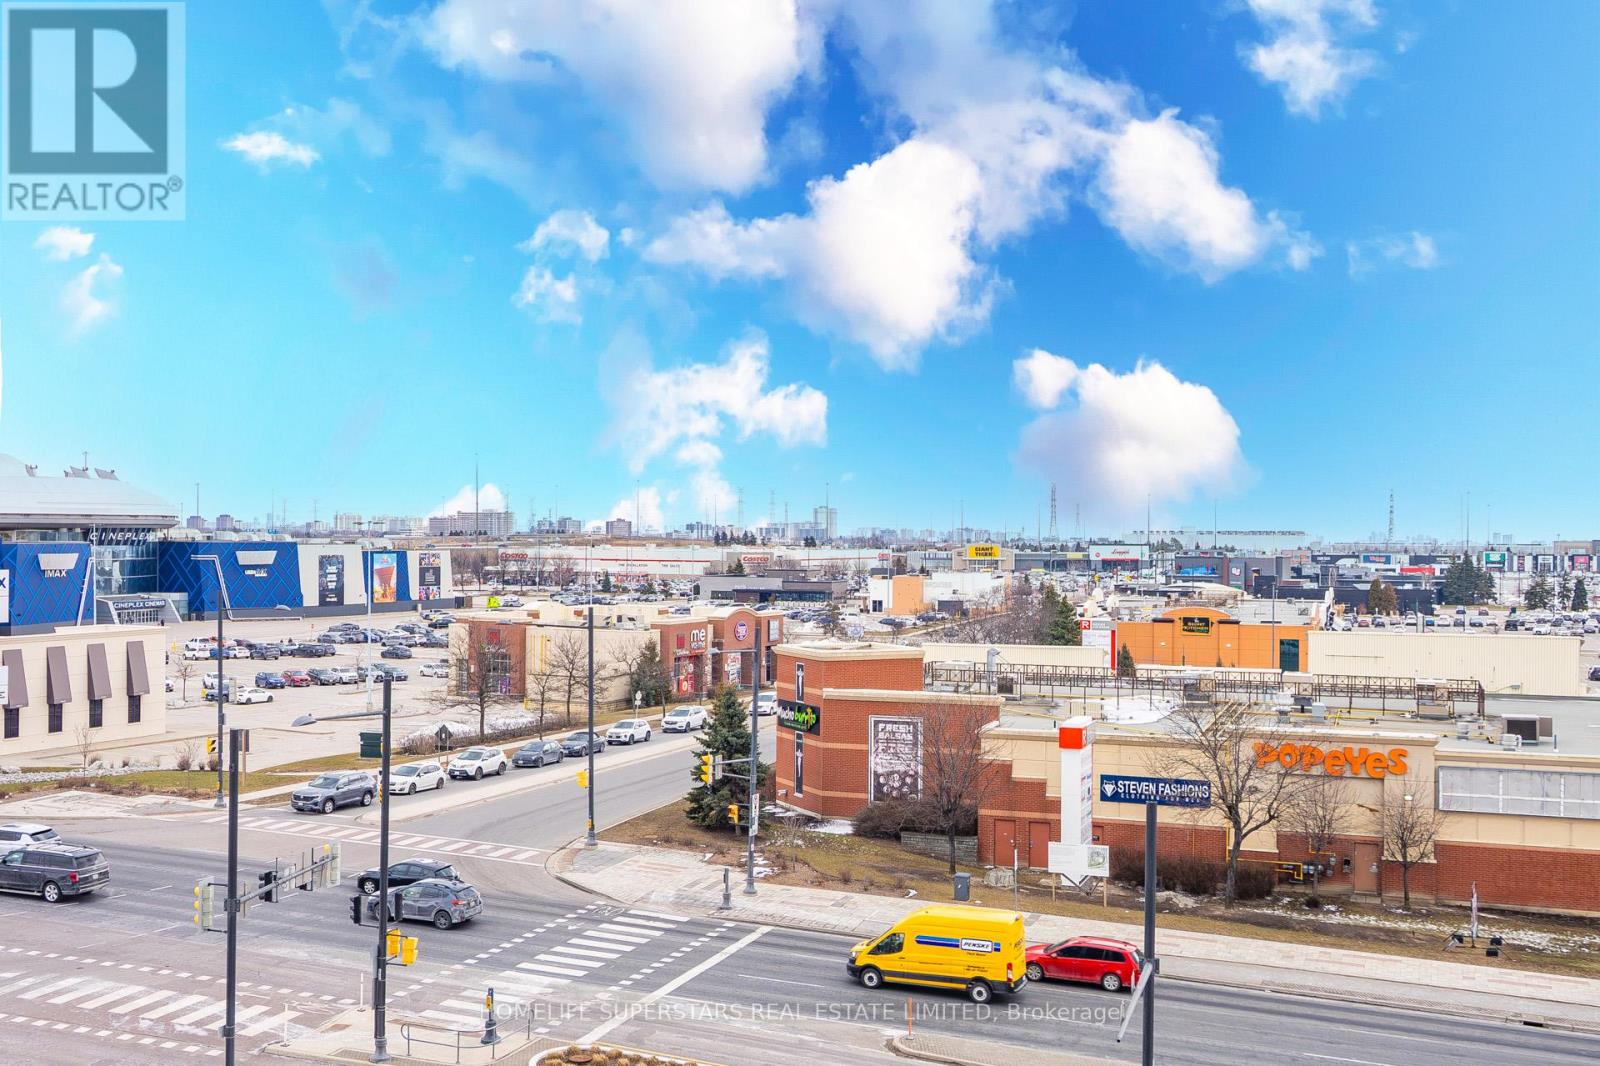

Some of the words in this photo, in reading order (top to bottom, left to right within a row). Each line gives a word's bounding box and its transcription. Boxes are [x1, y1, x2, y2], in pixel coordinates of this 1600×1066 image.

[90, 532, 151, 541] CINEPLEX
[45, 569, 67, 578] IMAX
[879, 723, 913, 733] FRESH
[1117, 780, 1156, 795] STEVEN
[1158, 783, 1209, 798] FASHIONS
[963, 942, 990, 950] PENSKE
